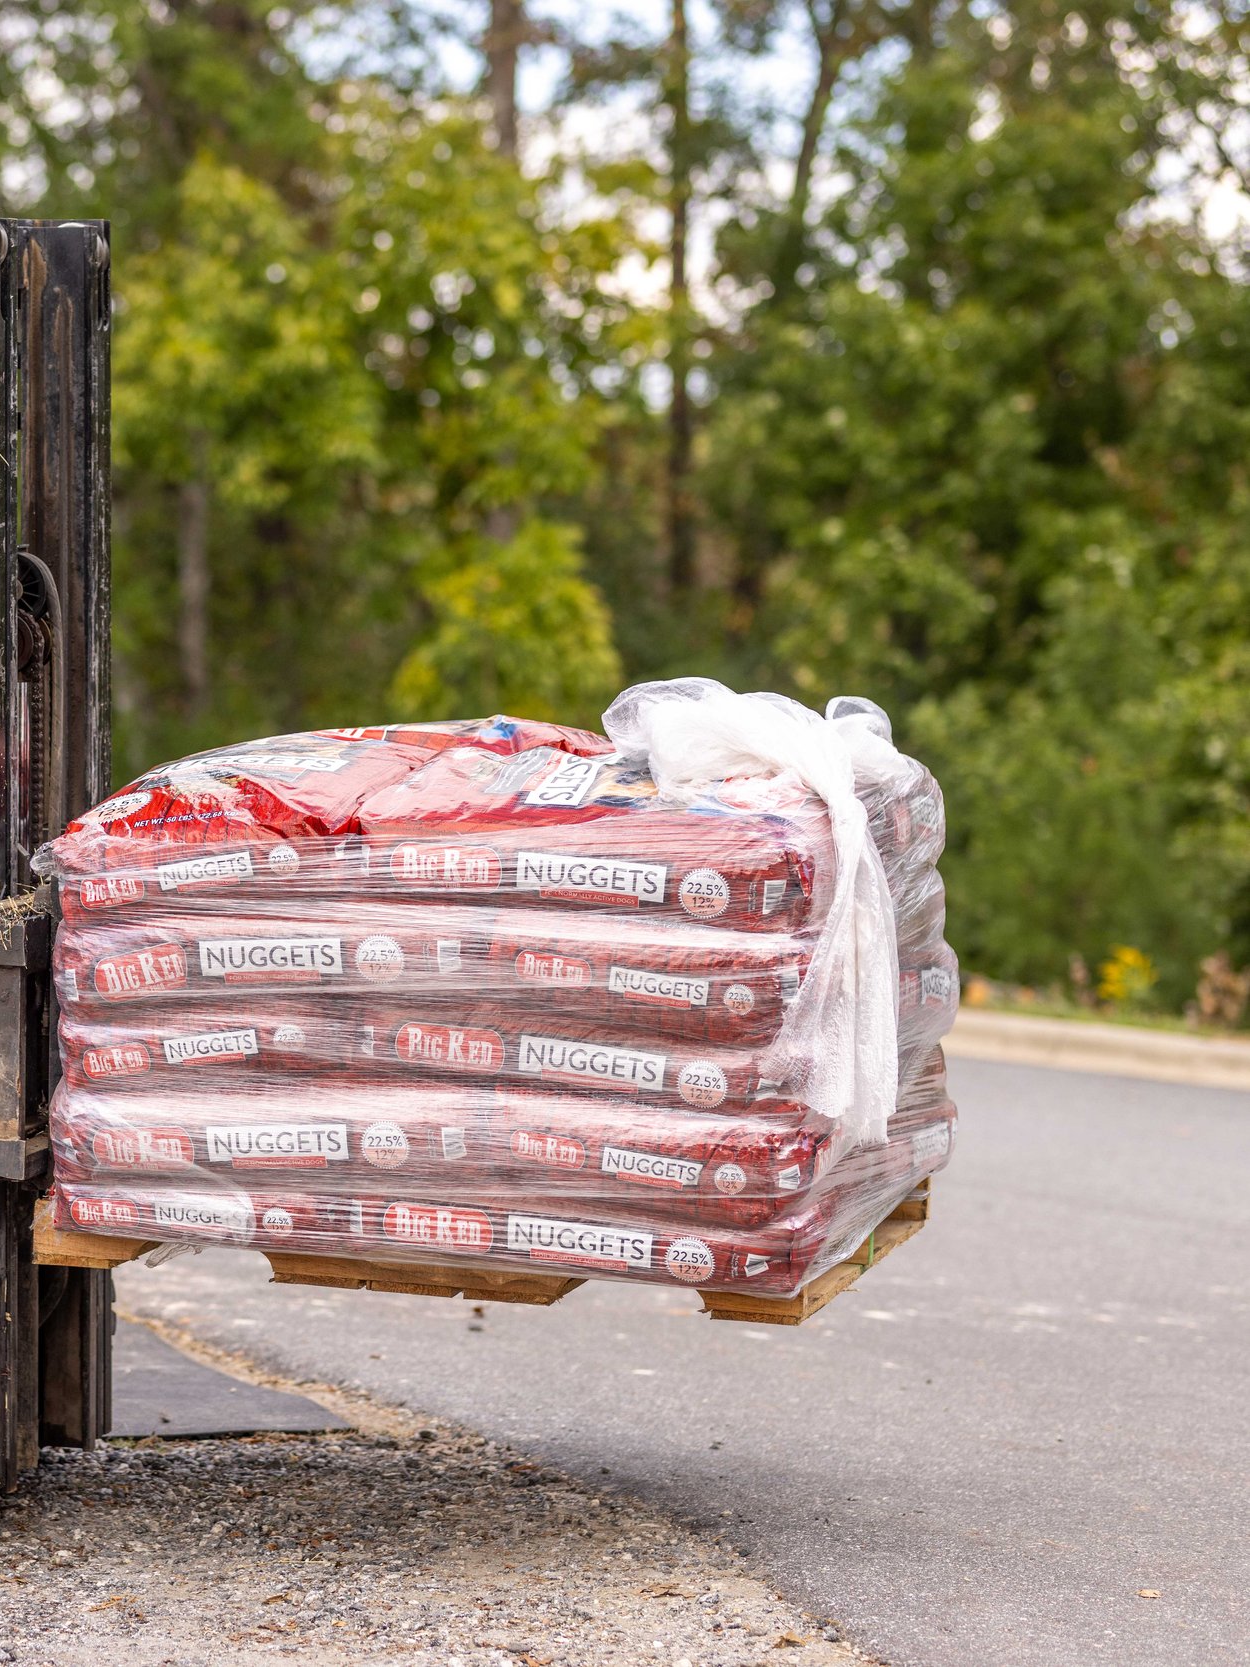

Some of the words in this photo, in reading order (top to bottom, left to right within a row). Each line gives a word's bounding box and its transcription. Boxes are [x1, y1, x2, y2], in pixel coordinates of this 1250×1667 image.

[134, 820, 150, 828] NET
[151, 818, 164, 827] WT.
[162, 856, 250, 887] NUGGETS
[523, 858, 658, 896] NUGGETS
[687, 882, 724, 897] 22.5%
[593, 894, 616, 902] ACTIVE
[616, 897, 636, 905] DOGS
[692, 896, 715, 909] 12%
[206, 944, 335, 970] NUGGETS
[361, 949, 398, 962] 22.5%
[614, 970, 705, 1000] NUGGETS
[728, 992, 751, 1002] 22.5%
[167, 1033, 253, 1059] NUGGETS
[526, 1042, 657, 1083] NUGGETS
[685, 1073, 721, 1090] 22.5%
[690, 1088, 713, 1101] 12%
[214, 1130, 342, 1155] NUGGETS
[367, 1135, 403, 1148] 22.5%
[375, 1149, 398, 1160] 12%
[606, 1152, 697, 1182] NUGGETS
[719, 1171, 742, 1182] 22.5%
[723, 1180, 737, 1189] 12%
[266, 1216, 290, 1225] 22.5%
[514, 1221, 645, 1261] NUGGETS
[672, 1250, 708, 1266] 22.5%
[678, 1264, 702, 1276] 12%
